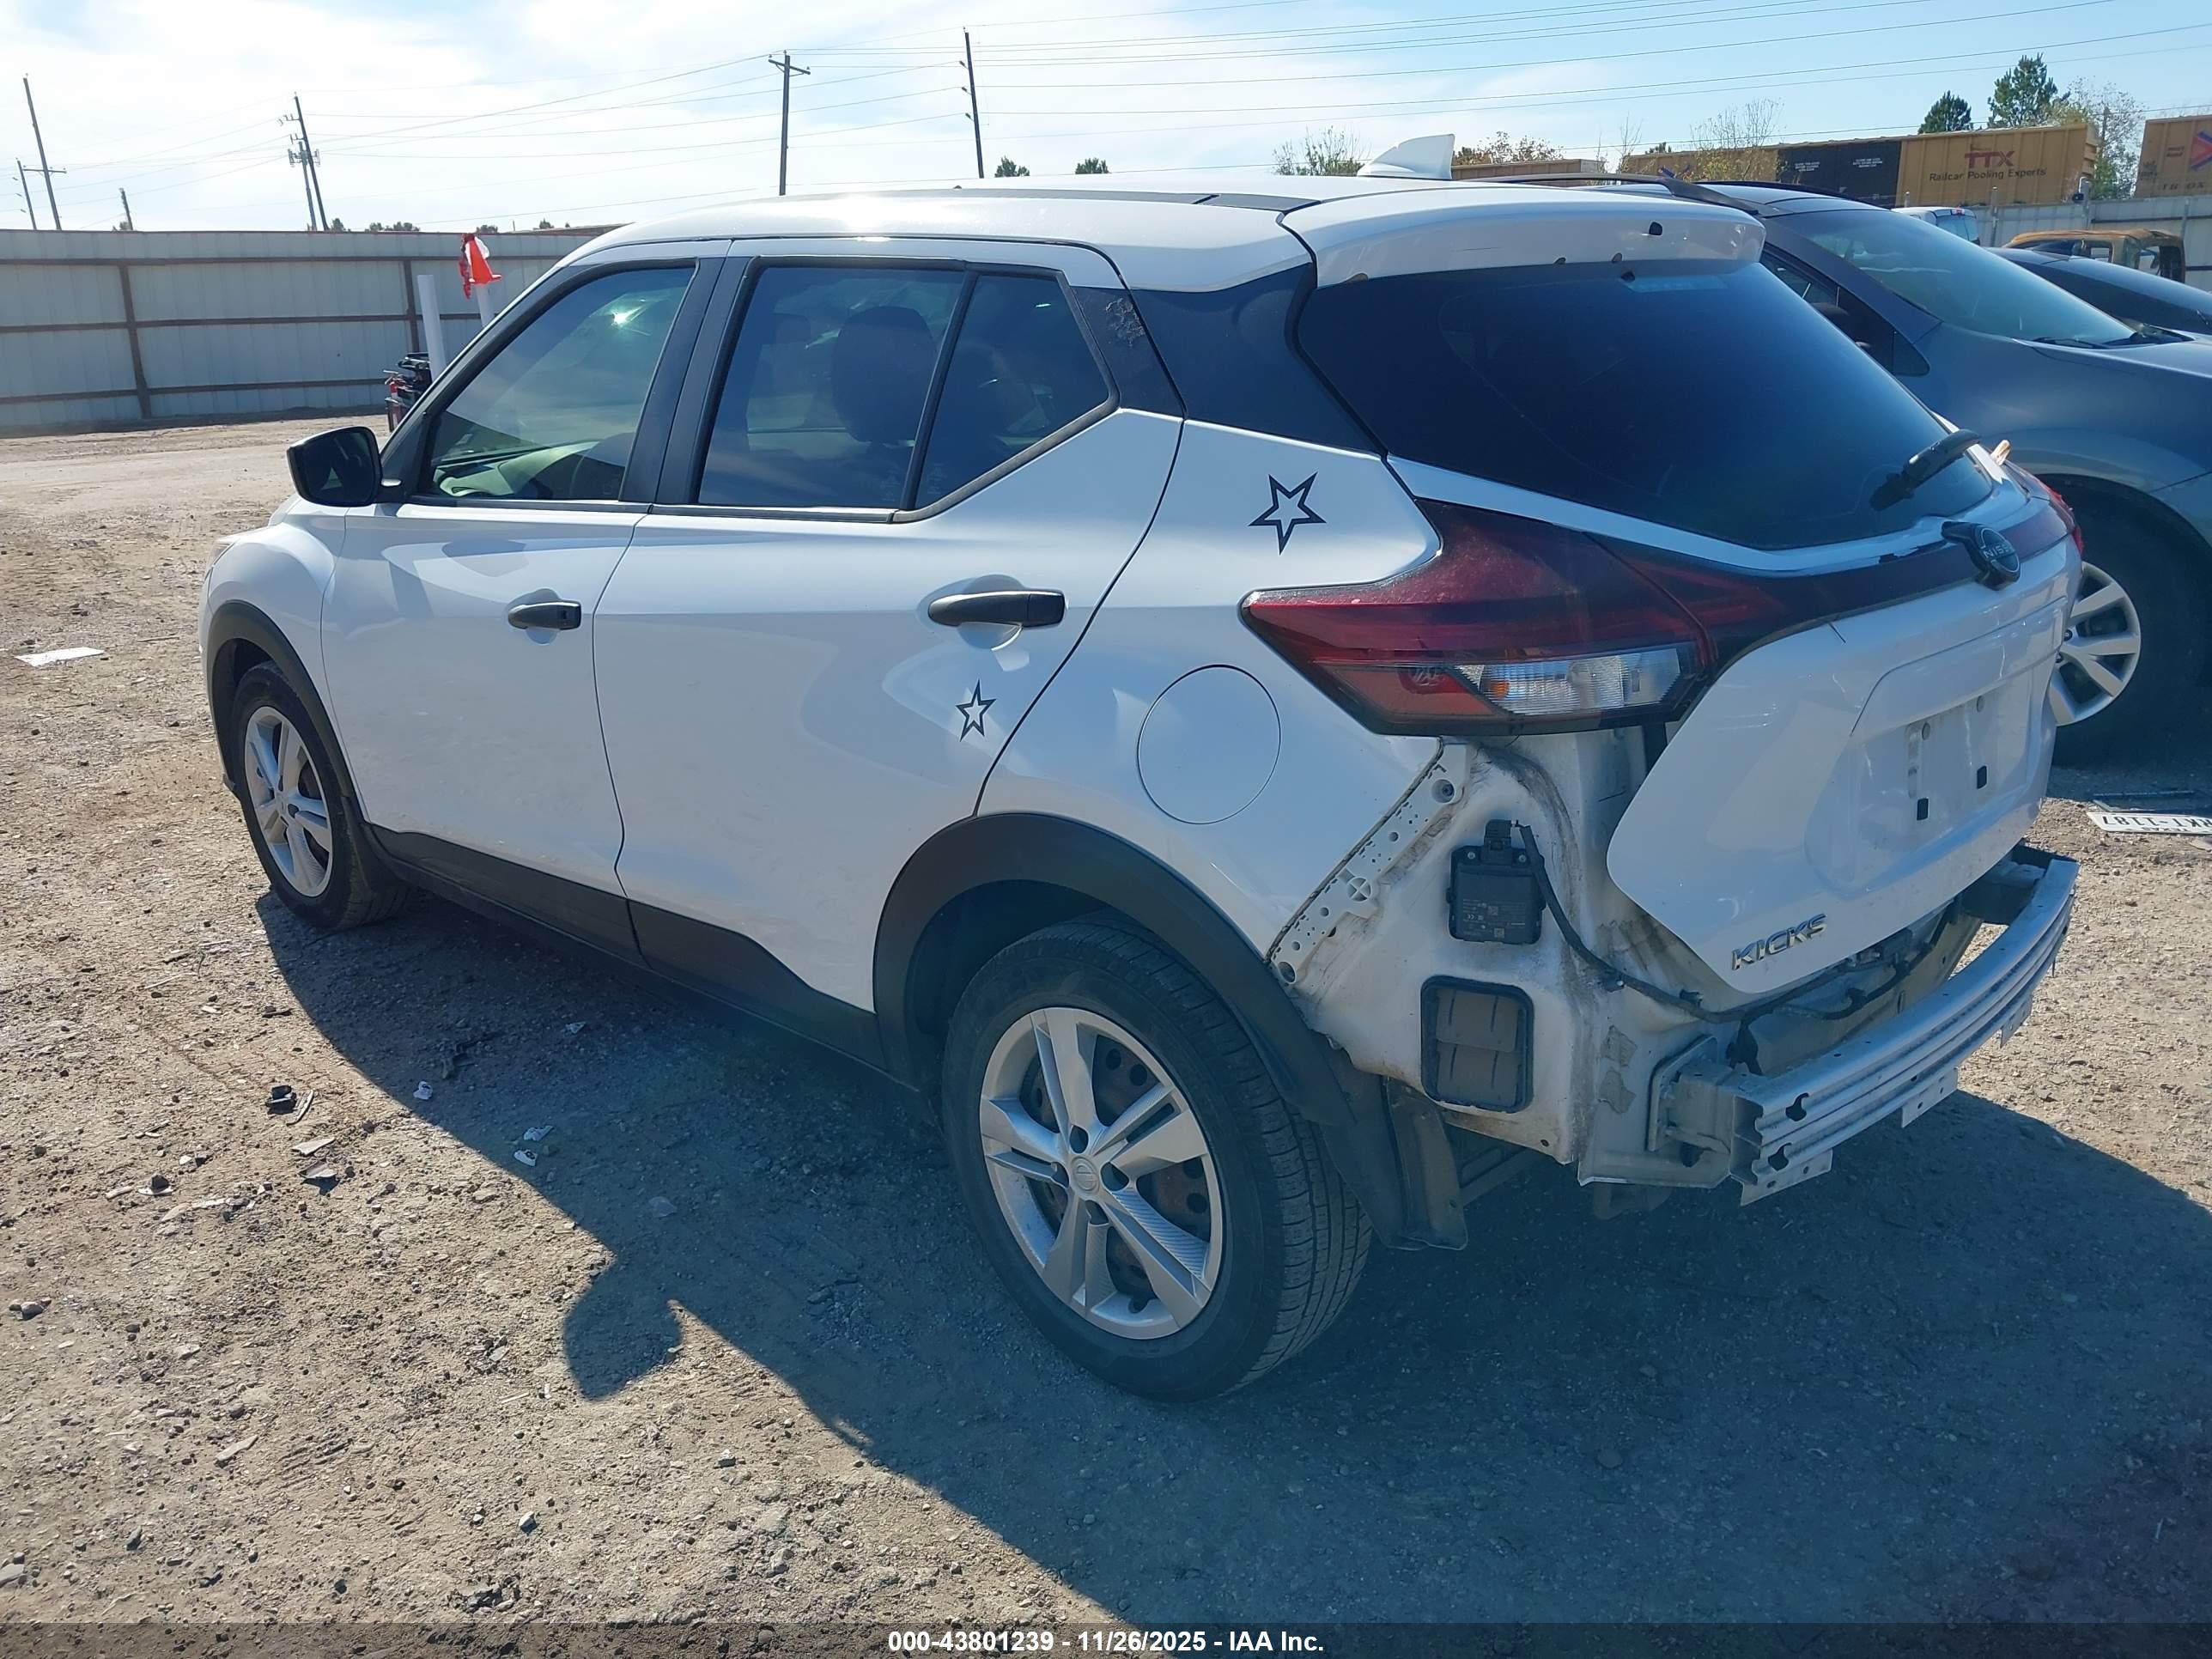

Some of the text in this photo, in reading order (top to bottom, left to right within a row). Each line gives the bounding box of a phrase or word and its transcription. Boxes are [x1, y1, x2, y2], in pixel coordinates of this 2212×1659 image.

[1964, 150, 2014, 168] TTX
[1929, 167, 2047, 181] Railcar Pooling Experts
[1731, 913, 1826, 970] KICKS
